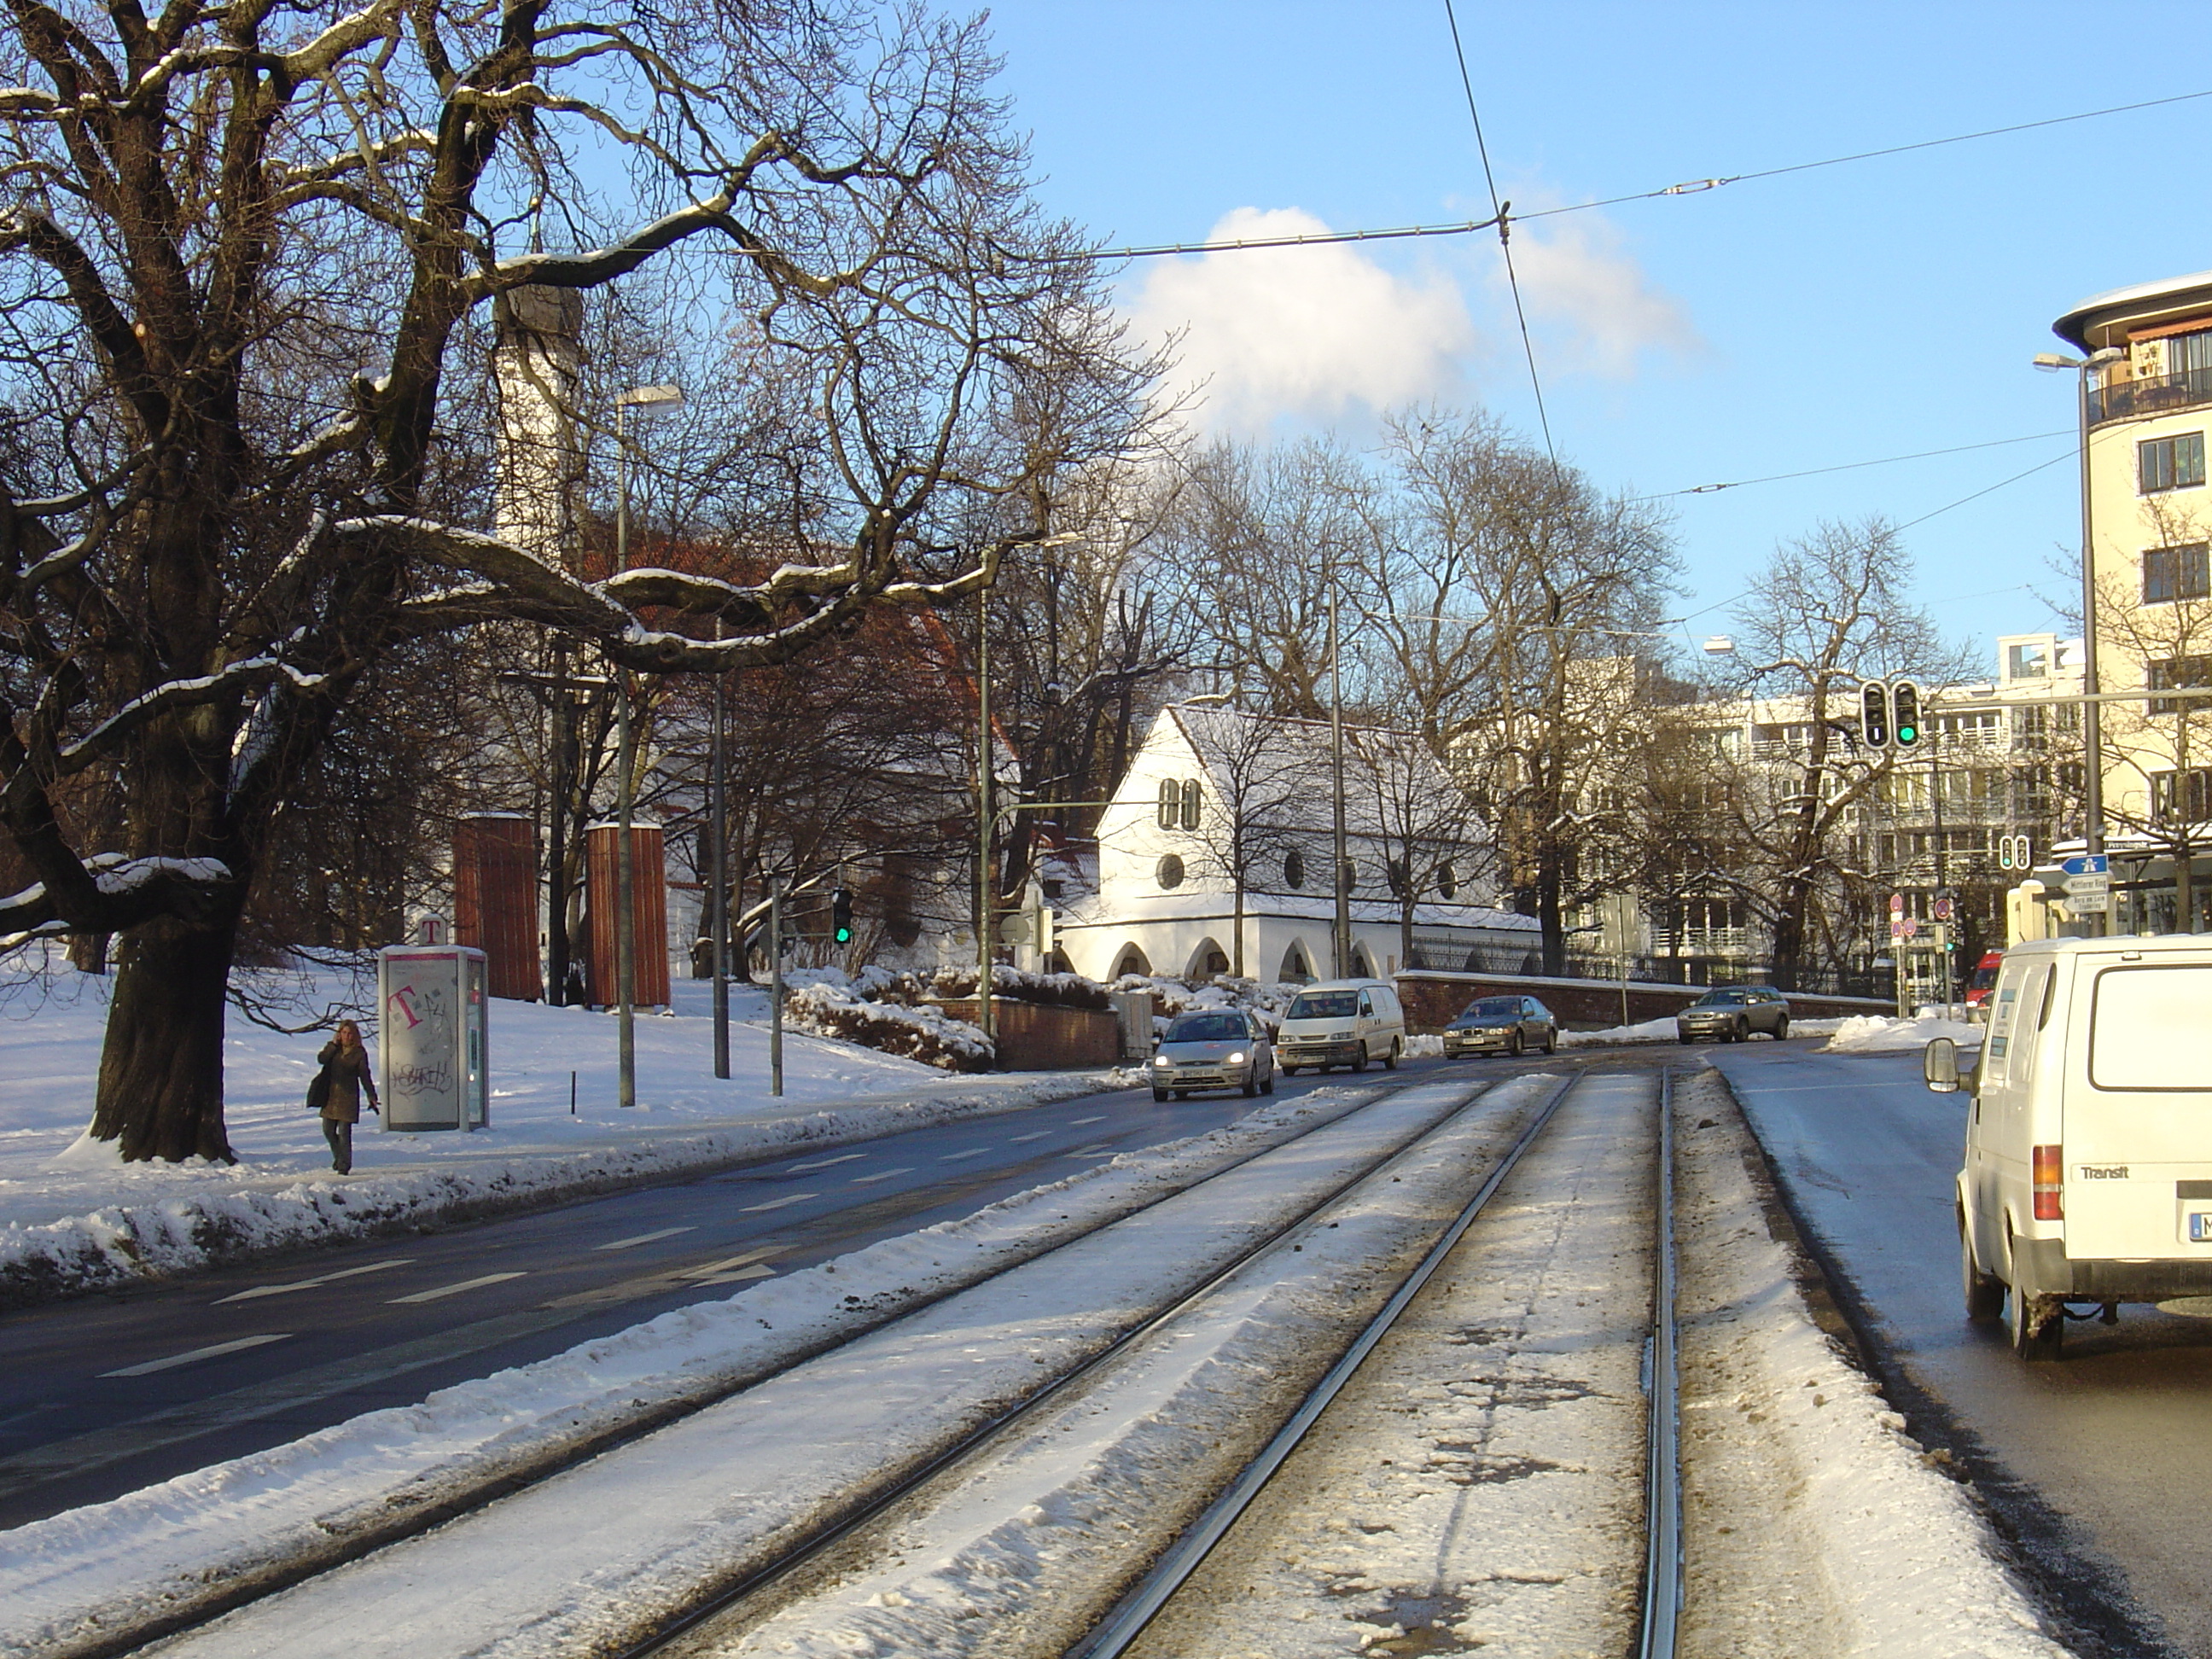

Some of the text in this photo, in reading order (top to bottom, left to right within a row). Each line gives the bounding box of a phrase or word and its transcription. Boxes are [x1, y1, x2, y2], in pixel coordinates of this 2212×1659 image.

[422, 920, 440, 944] T
[387, 985, 423, 1030] T
[2081, 1167, 2129, 1179] Transit
